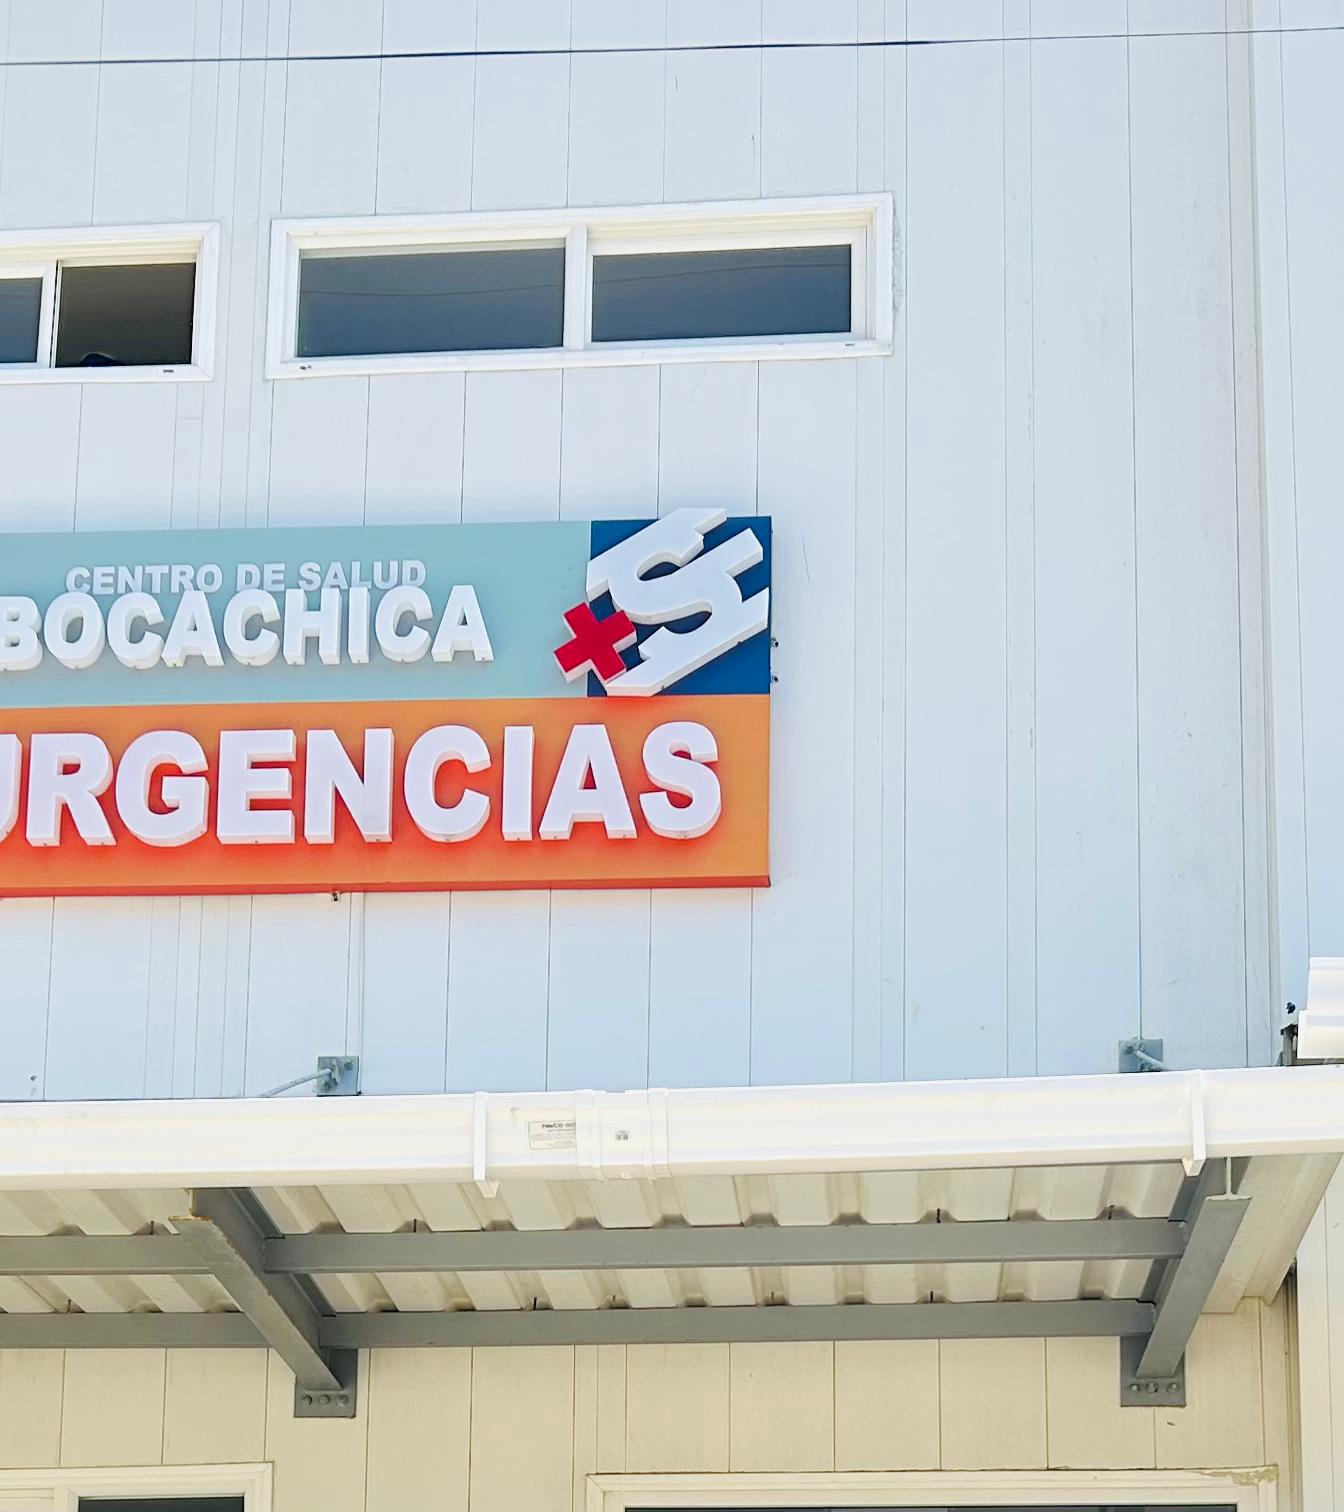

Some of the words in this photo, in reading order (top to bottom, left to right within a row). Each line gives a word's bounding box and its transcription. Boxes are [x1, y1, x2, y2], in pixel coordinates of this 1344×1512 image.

[66, 564, 224, 595] CENTRO
[236, 563, 288, 594] DE
[297, 560, 427, 590] SALUD
